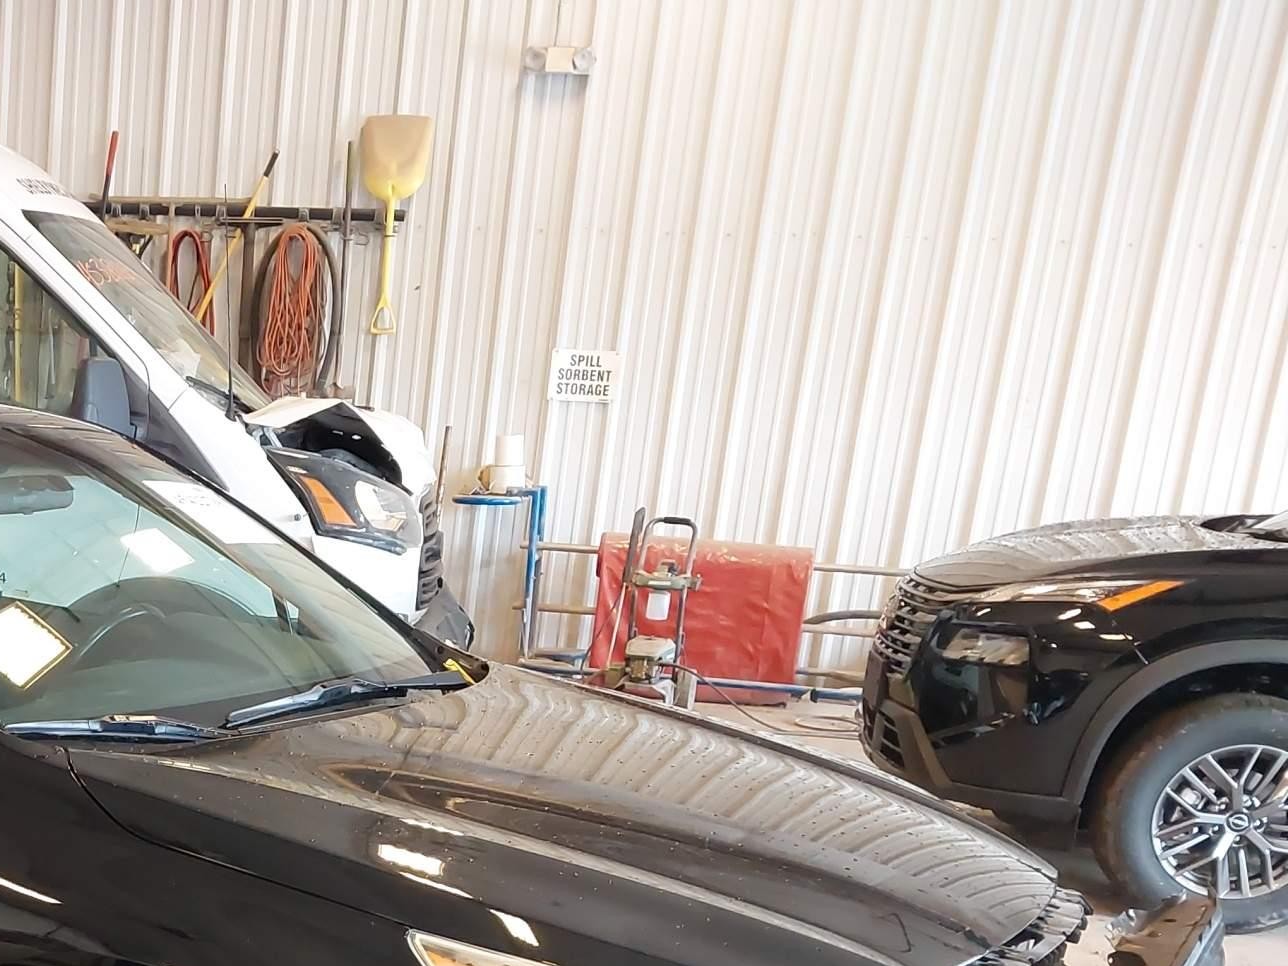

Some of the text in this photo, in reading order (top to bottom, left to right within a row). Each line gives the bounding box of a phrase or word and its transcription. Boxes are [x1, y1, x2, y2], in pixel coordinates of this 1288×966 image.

[569, 354, 602, 368] SPILL
[558, 368, 612, 382] SORBENT
[556, 382, 610, 396] STORAGE
